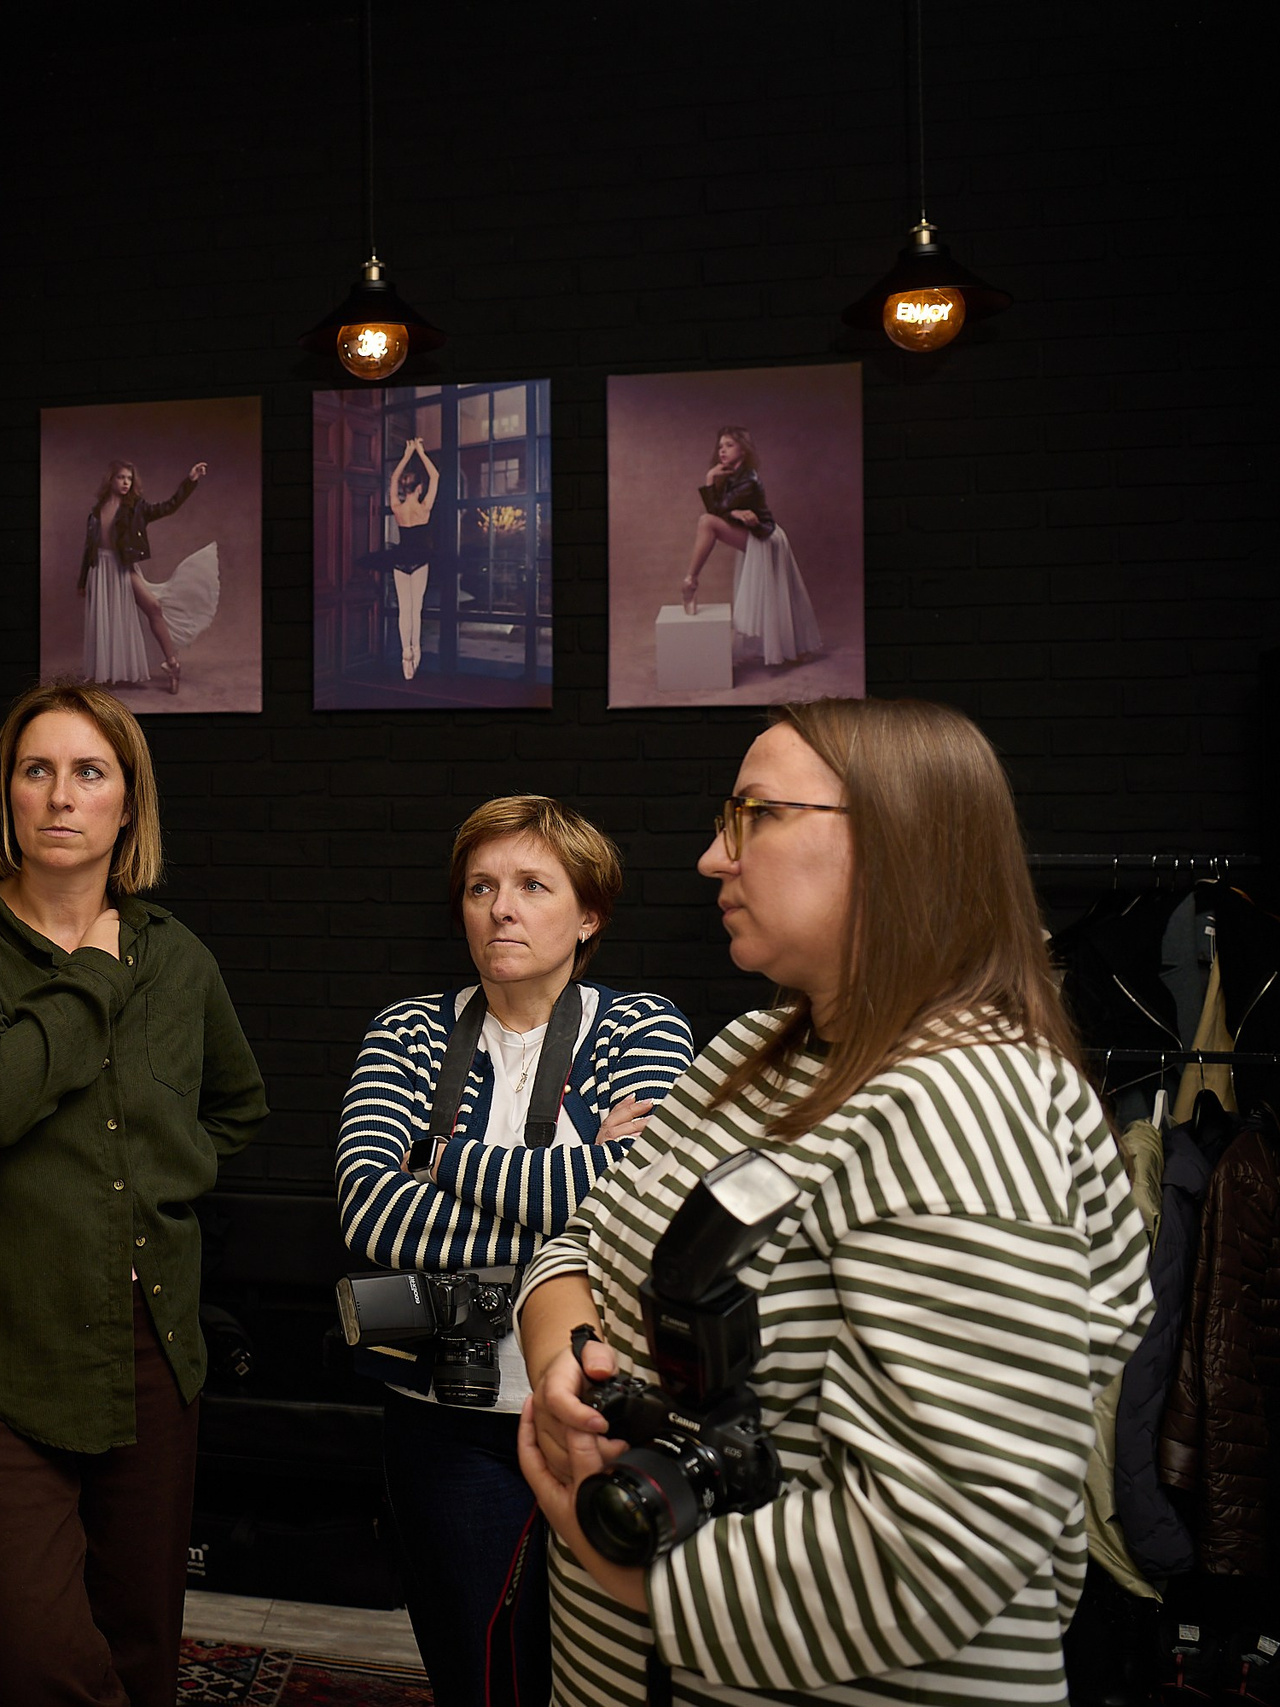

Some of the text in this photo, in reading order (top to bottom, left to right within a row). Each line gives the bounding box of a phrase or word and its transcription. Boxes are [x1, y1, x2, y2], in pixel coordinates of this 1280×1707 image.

[897, 303, 954, 321] ENJOY
[668, 1412, 701, 1433] Canon
[723, 1445, 743, 1459] EOS
